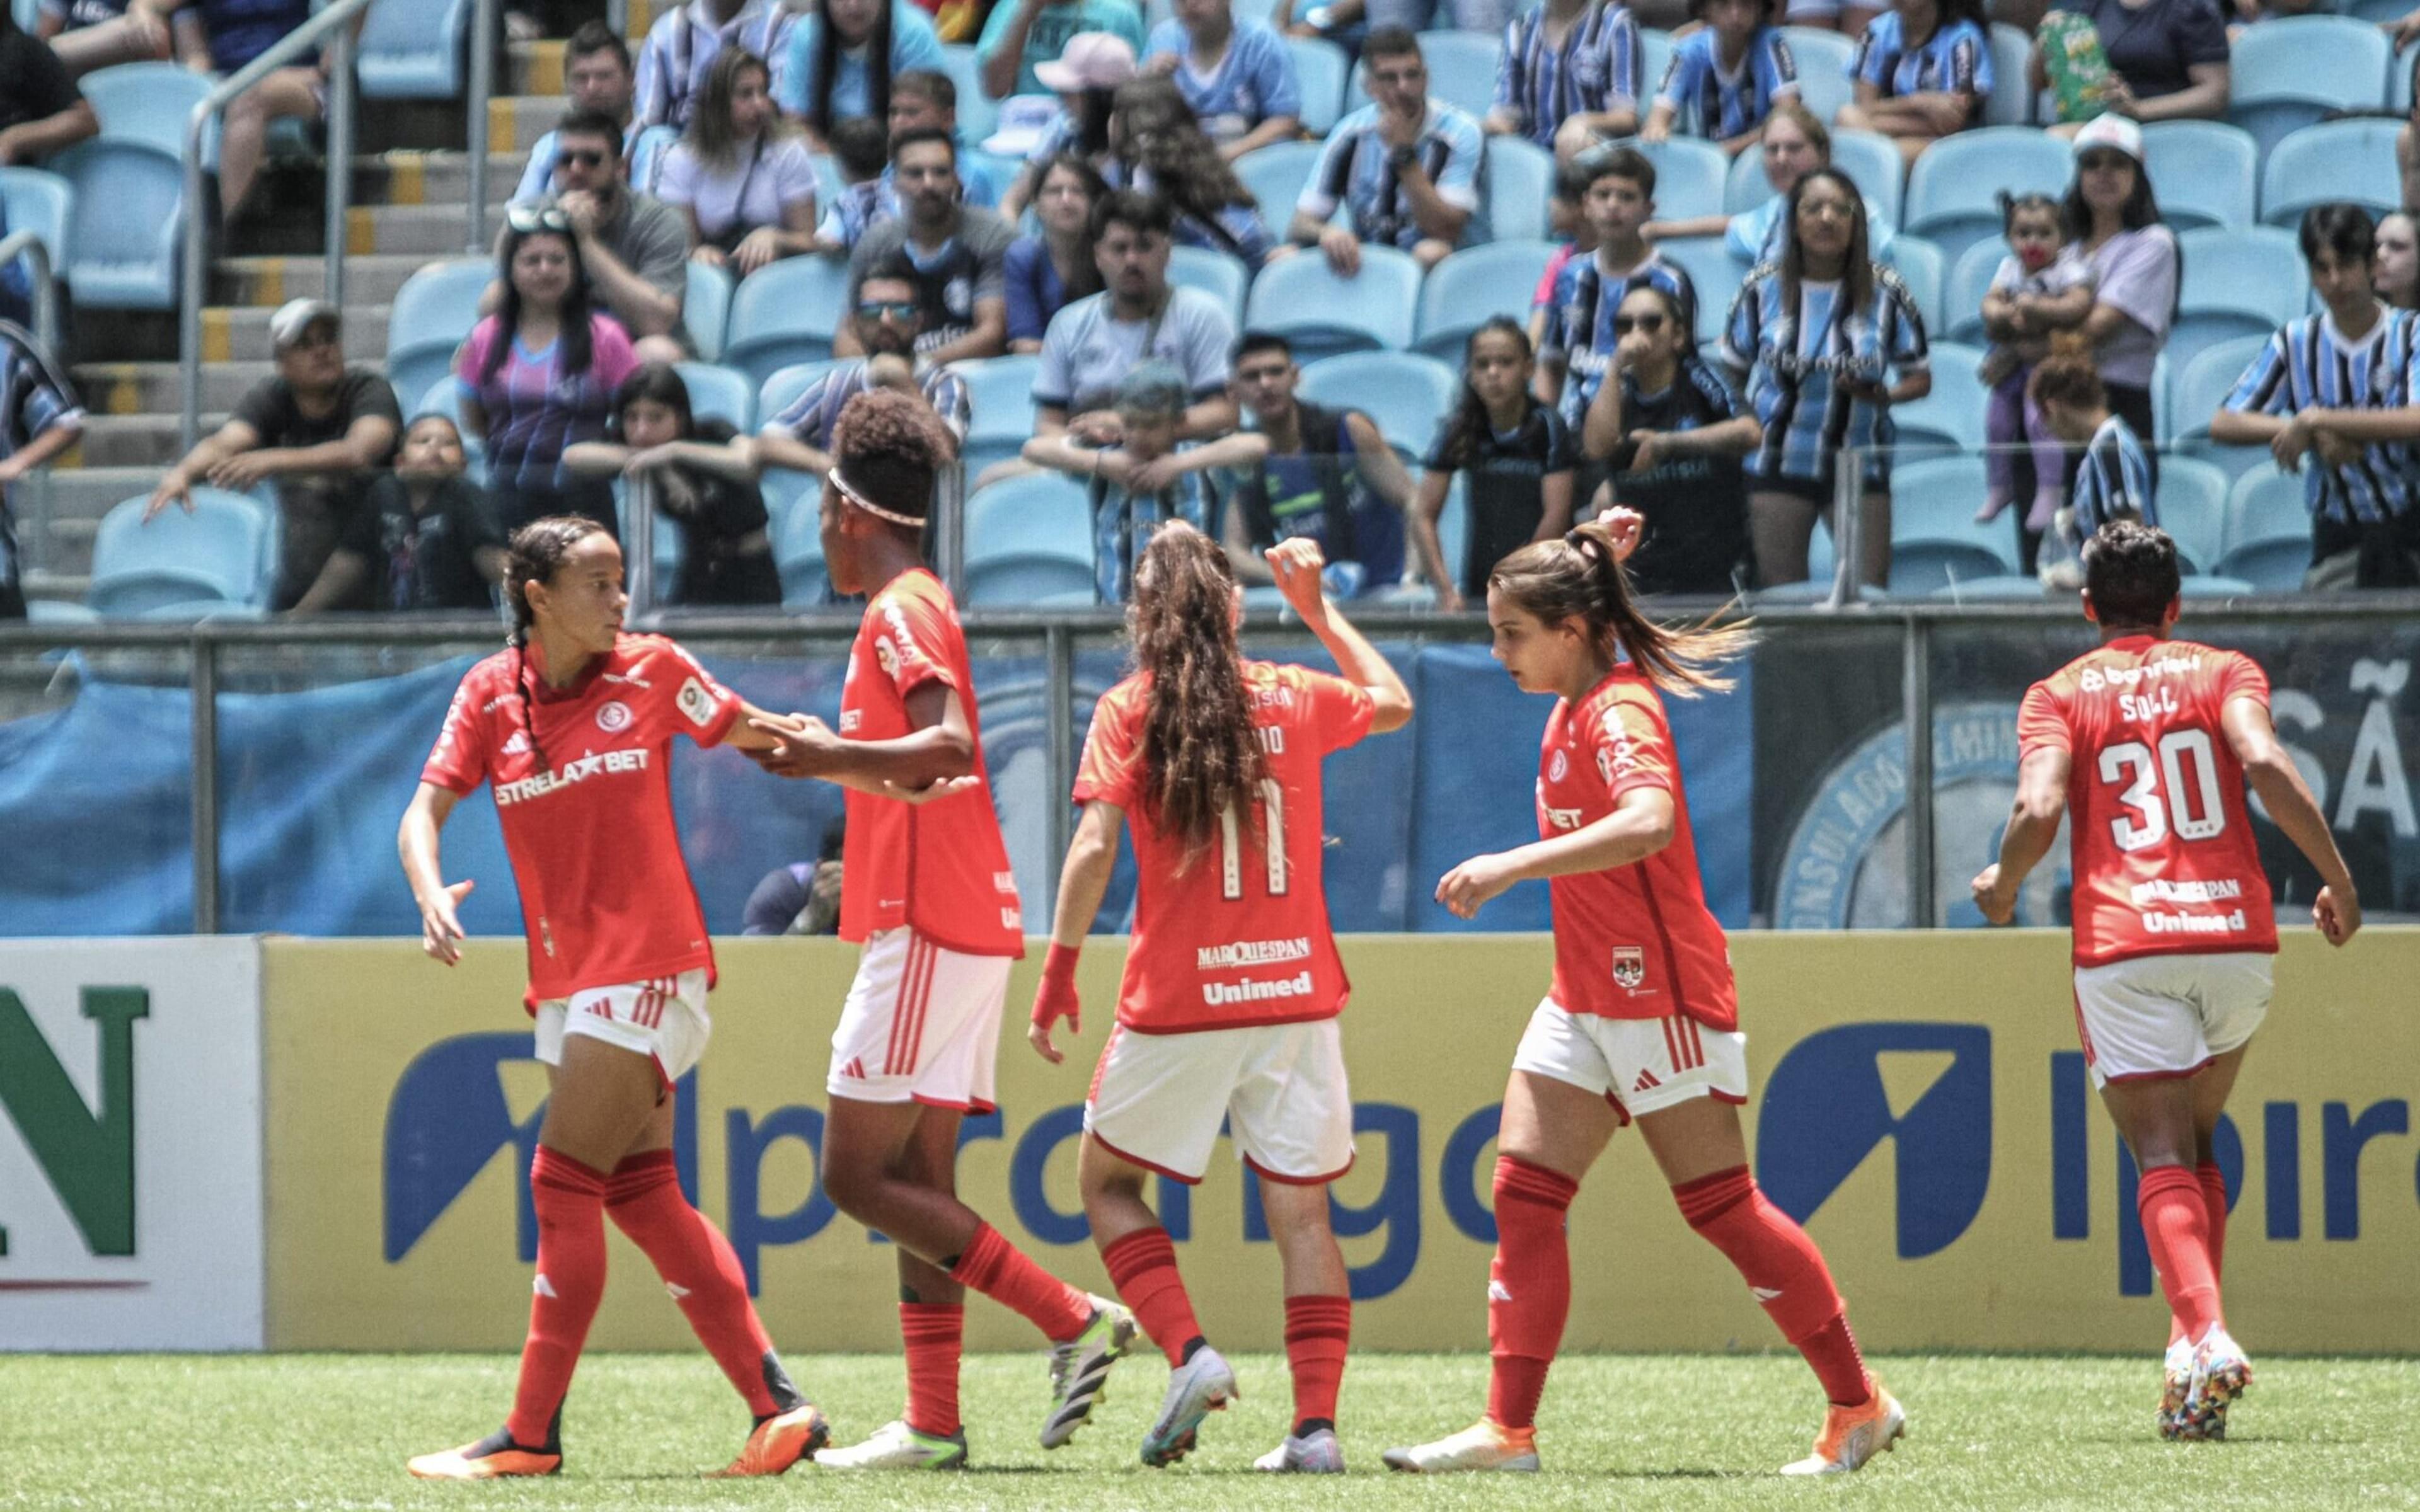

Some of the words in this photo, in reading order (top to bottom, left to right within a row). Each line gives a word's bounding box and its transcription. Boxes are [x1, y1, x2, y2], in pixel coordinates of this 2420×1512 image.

[2119, 685, 2179, 722] SOLL
[2098, 728, 2225, 852] 30
[1219, 778, 1287, 899] 11
[1197, 937, 1310, 966] MARQUESPAN
[1202, 971, 1313, 1006] Unimed
